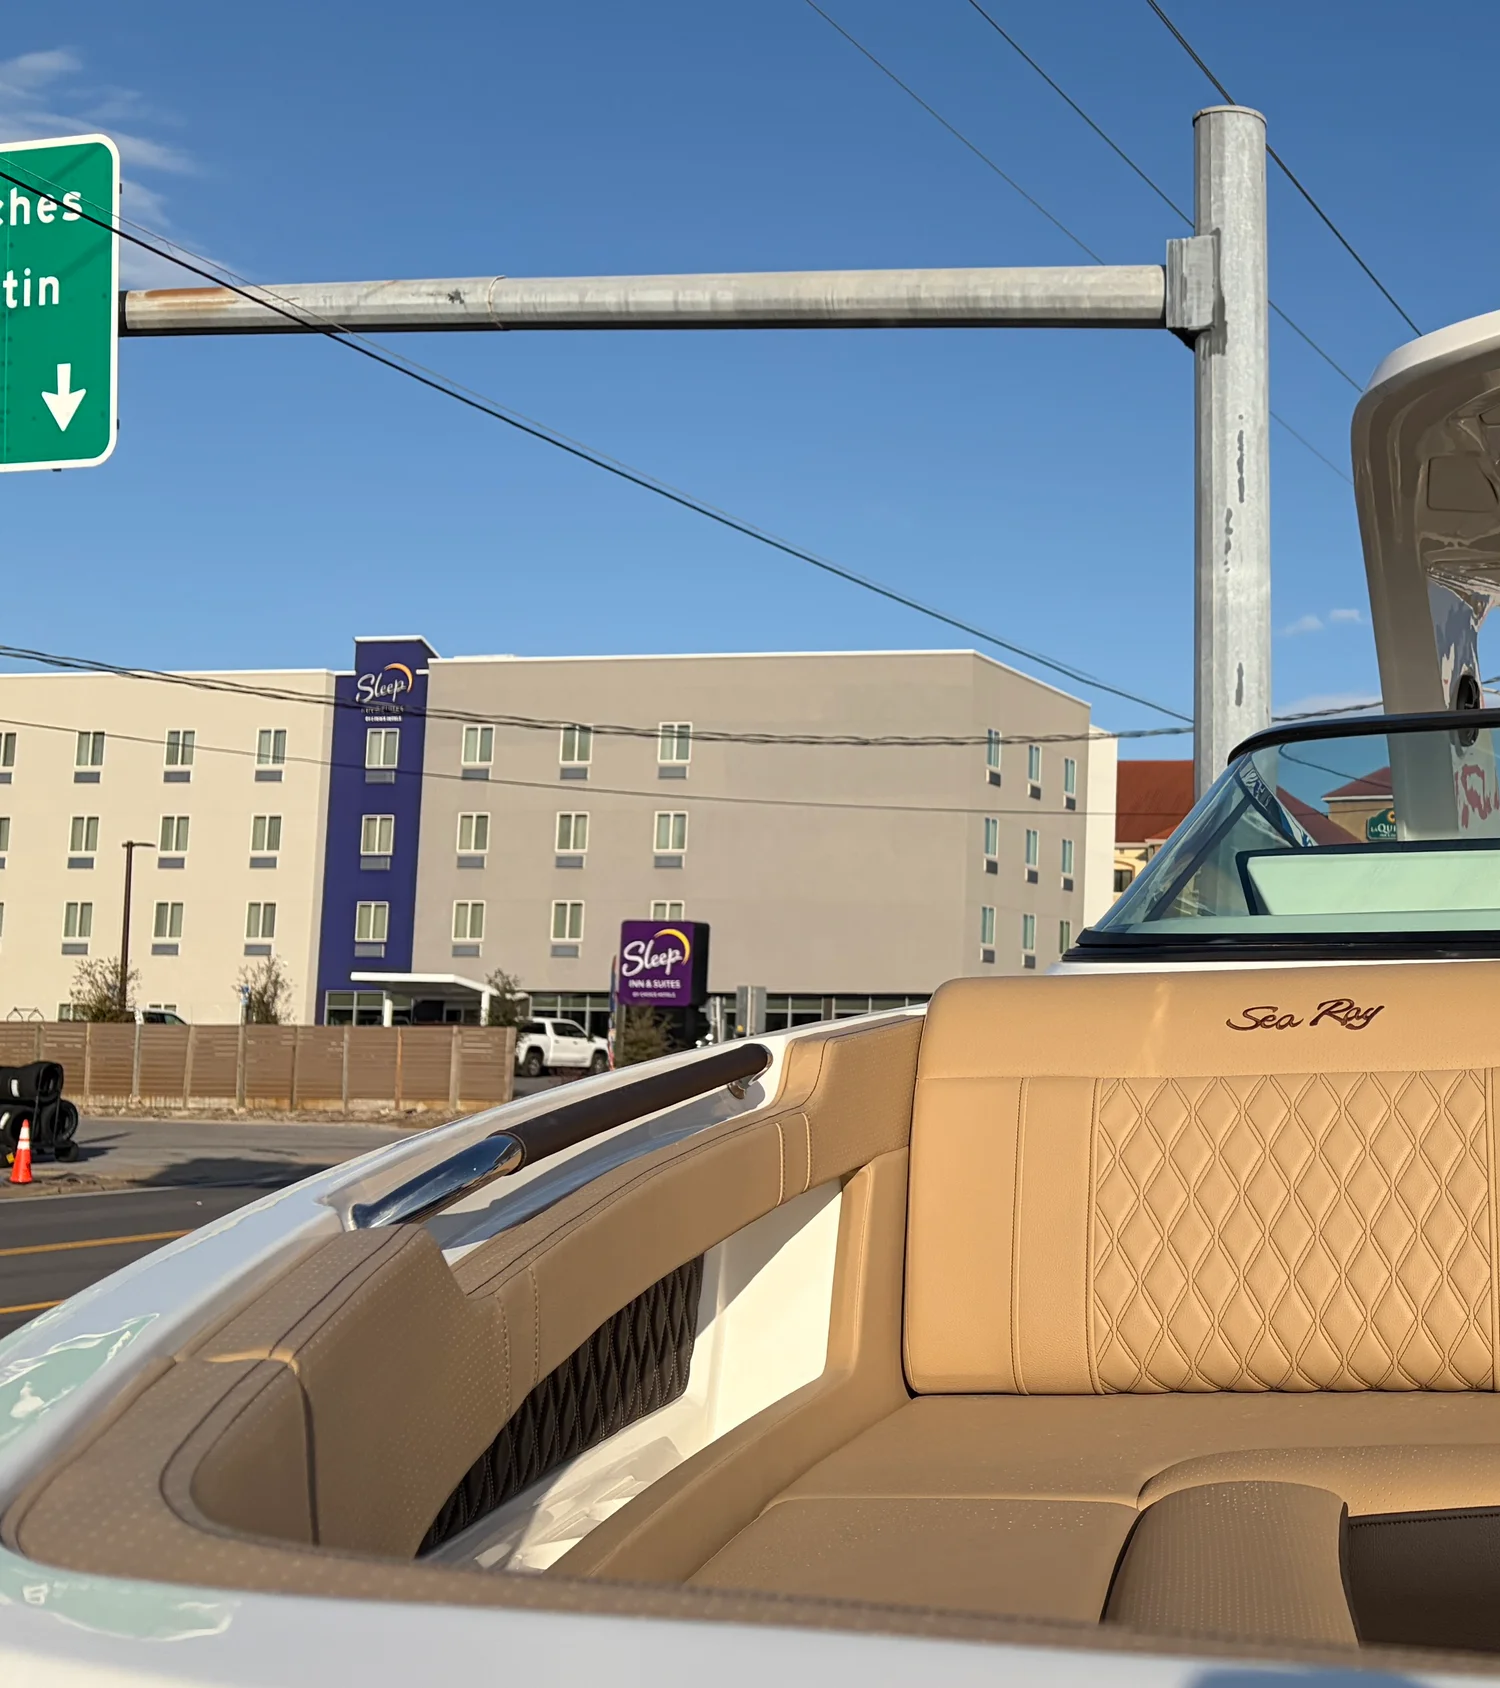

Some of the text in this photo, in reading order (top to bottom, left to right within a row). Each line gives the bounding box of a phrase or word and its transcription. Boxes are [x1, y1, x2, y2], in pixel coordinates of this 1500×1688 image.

[0, 187, 83, 226] hes
[3, 267, 60, 309] tin
[355, 673, 407, 703] Sleep
[622, 939, 683, 977] Sleep
[1226, 998, 1385, 1031] Sea Ray
